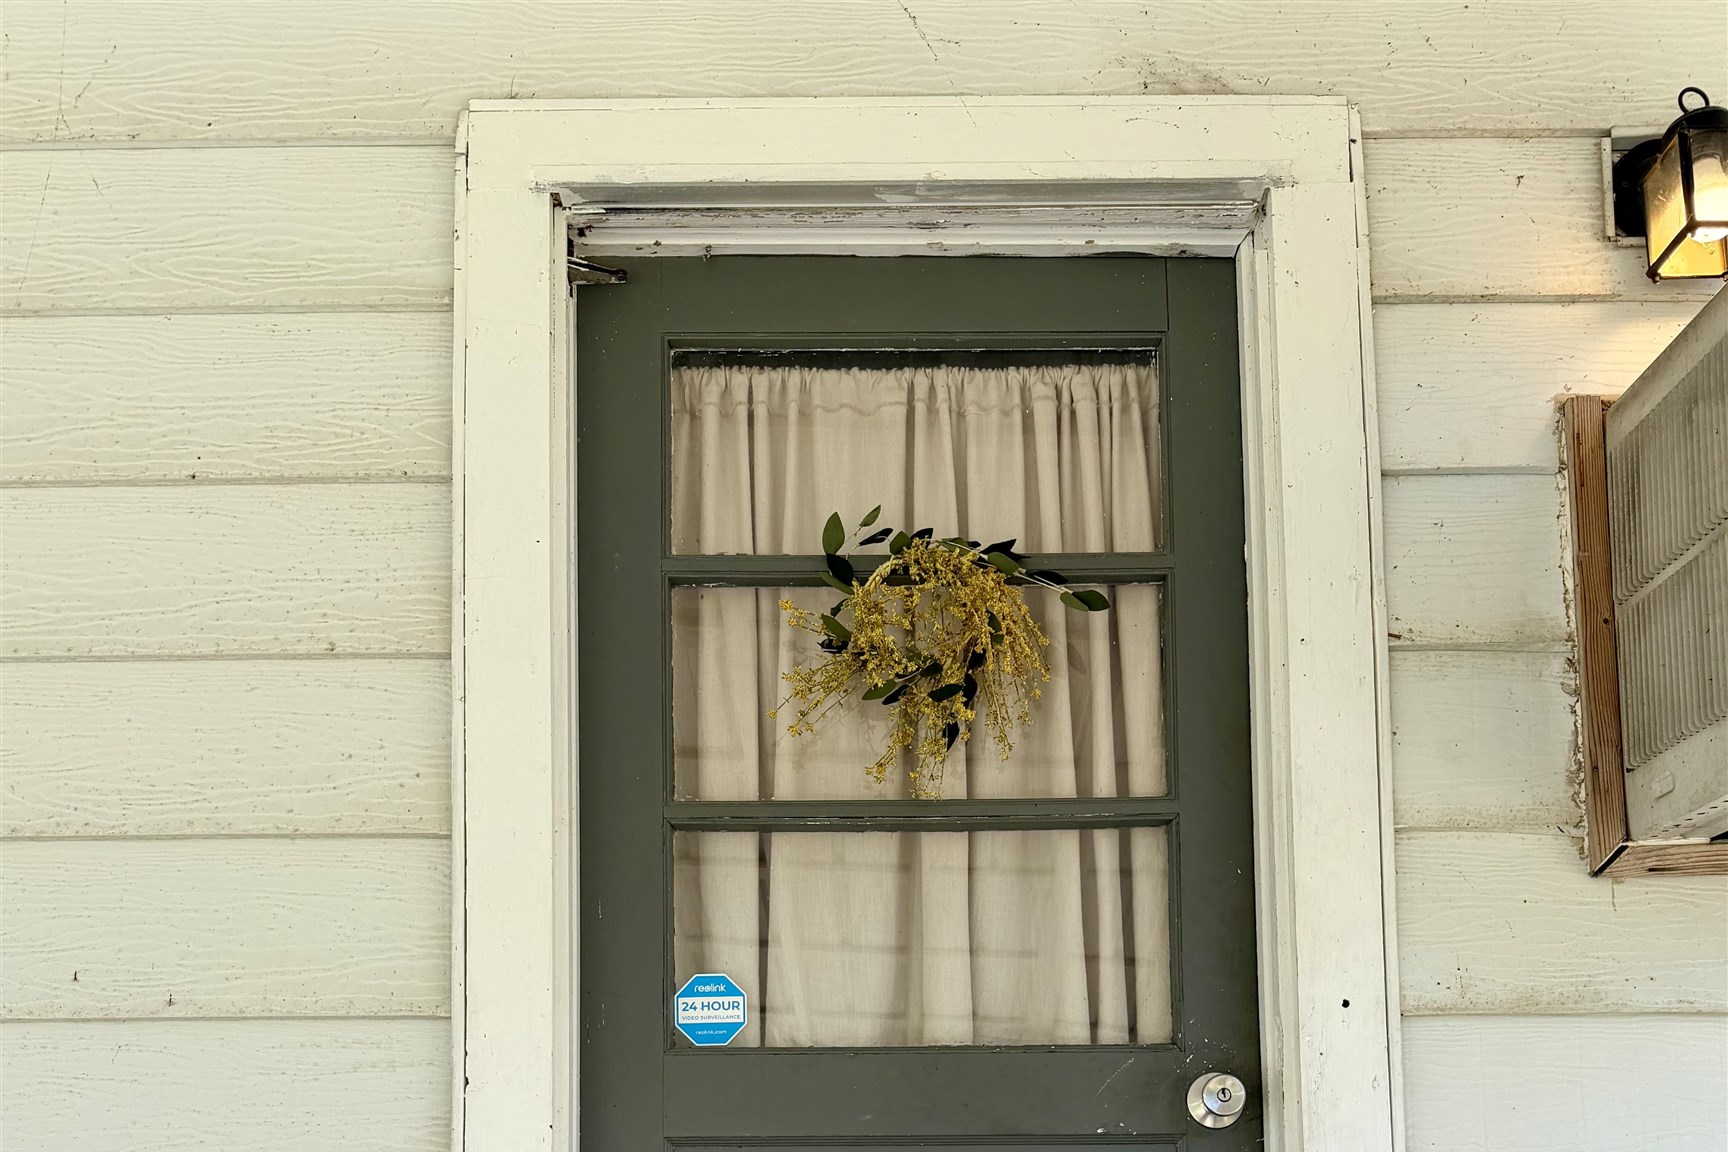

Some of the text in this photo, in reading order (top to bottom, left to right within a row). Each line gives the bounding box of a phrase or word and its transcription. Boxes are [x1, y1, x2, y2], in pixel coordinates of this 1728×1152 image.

[694, 983, 726, 993] reolink
[681, 1000, 741, 1012] 24 HOUR
